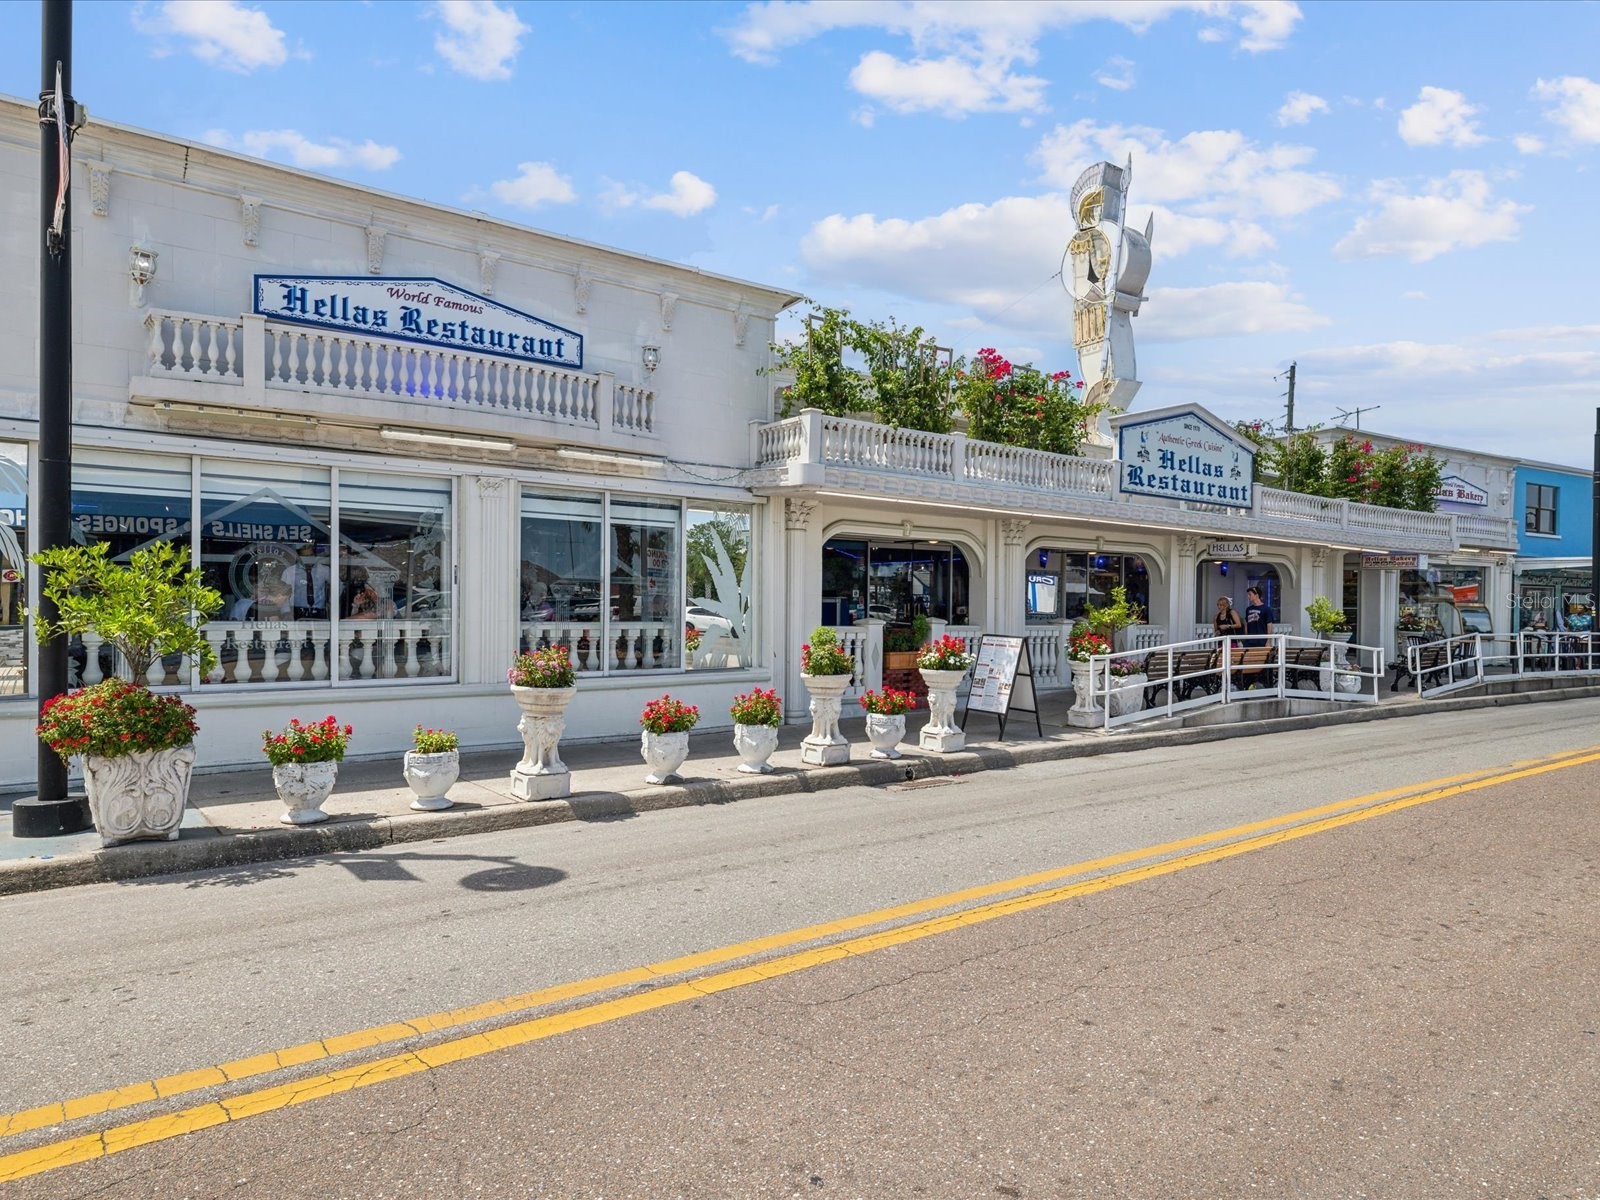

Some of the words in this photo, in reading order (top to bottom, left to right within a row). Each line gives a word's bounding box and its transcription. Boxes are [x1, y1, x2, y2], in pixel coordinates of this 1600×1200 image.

[386, 287, 430, 305] World
[434, 296, 484, 315] Famous
[279, 283, 388, 328] Hellas
[399, 305, 566, 358] Restaurant
[1185, 437, 1203, 449] Greek
[1157, 448, 1224, 478] Hellas
[1127, 464, 1248, 501] Restaurant
[1430, 487, 1454, 497] ellas
[1456, 488, 1484, 503] Bakery
[1212, 543, 1244, 552] HELLAS
[241, 616, 288, 629] Hellas
[225, 637, 308, 649] Restaurant
